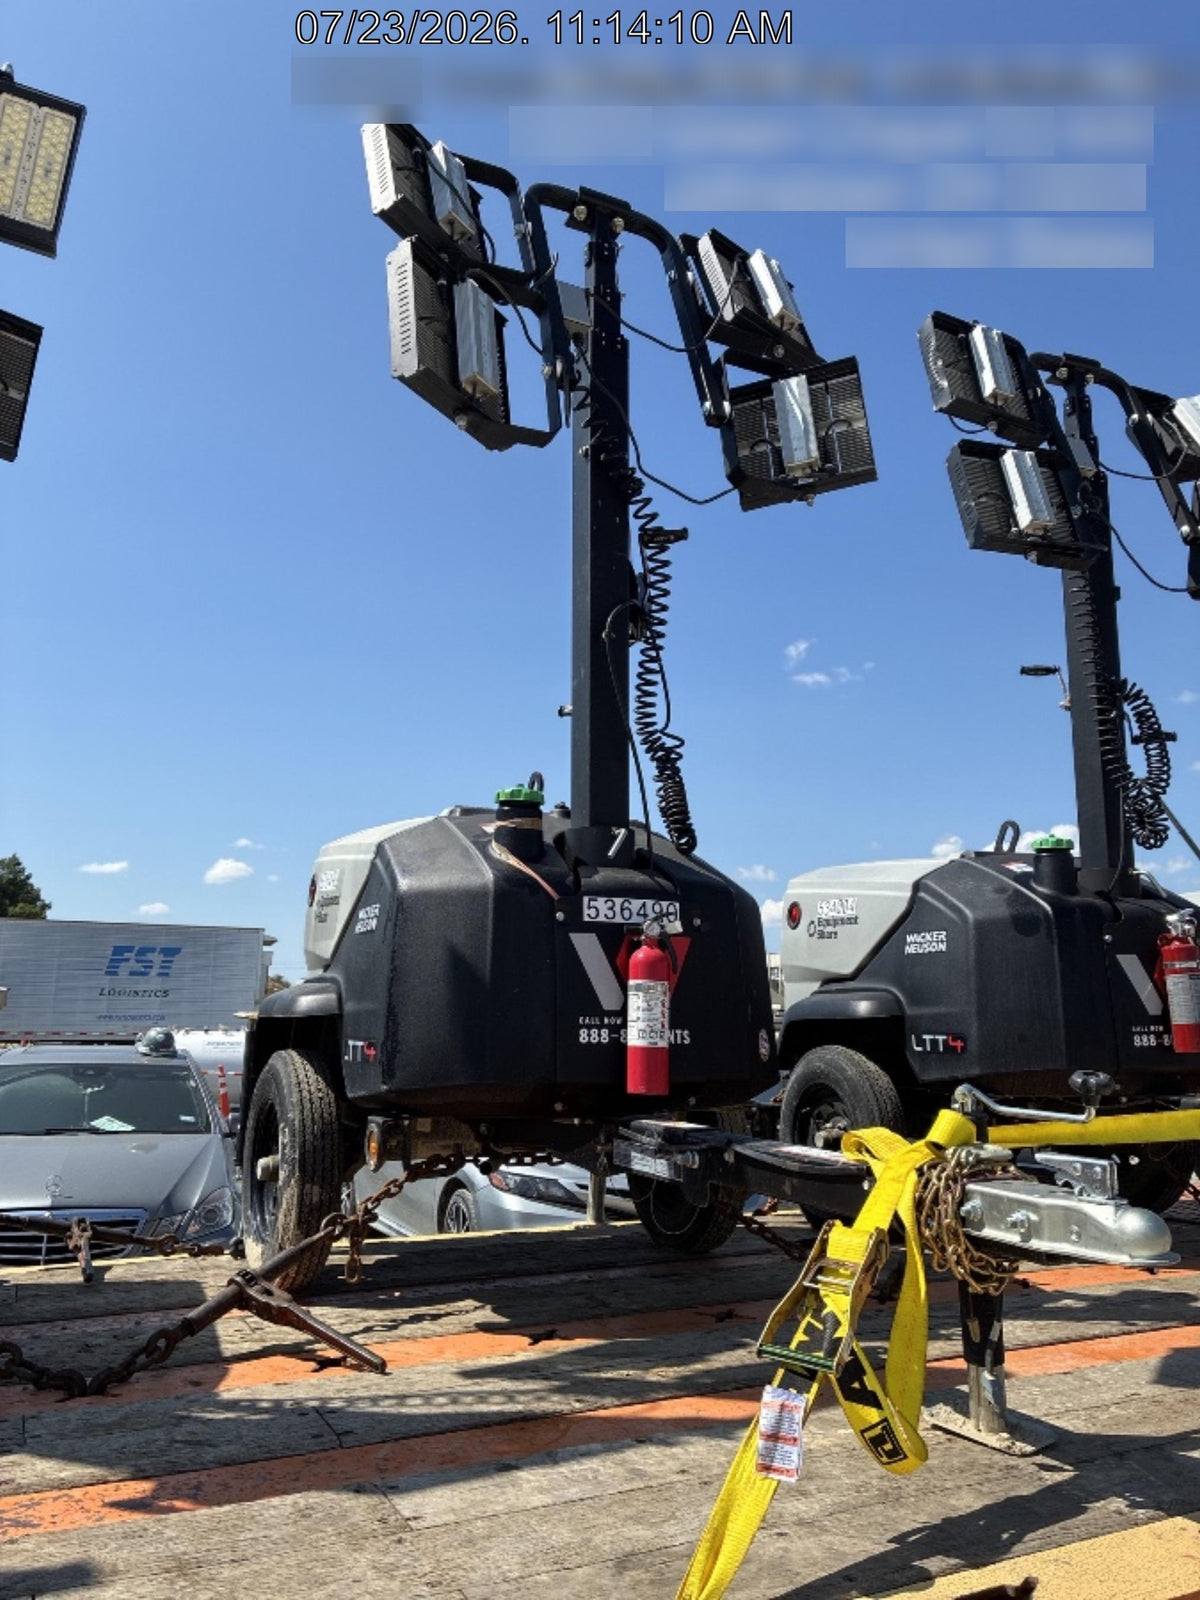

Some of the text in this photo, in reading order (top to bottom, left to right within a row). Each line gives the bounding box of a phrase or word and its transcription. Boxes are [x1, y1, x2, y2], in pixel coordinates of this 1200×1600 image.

[905, 930, 947, 945] WACKER
[903, 941, 947, 955] NEUSON
[104, 945, 183, 978] FST
[578, 1016, 600, 1025] CALL
[911, 1034, 965, 1054] LTT4
